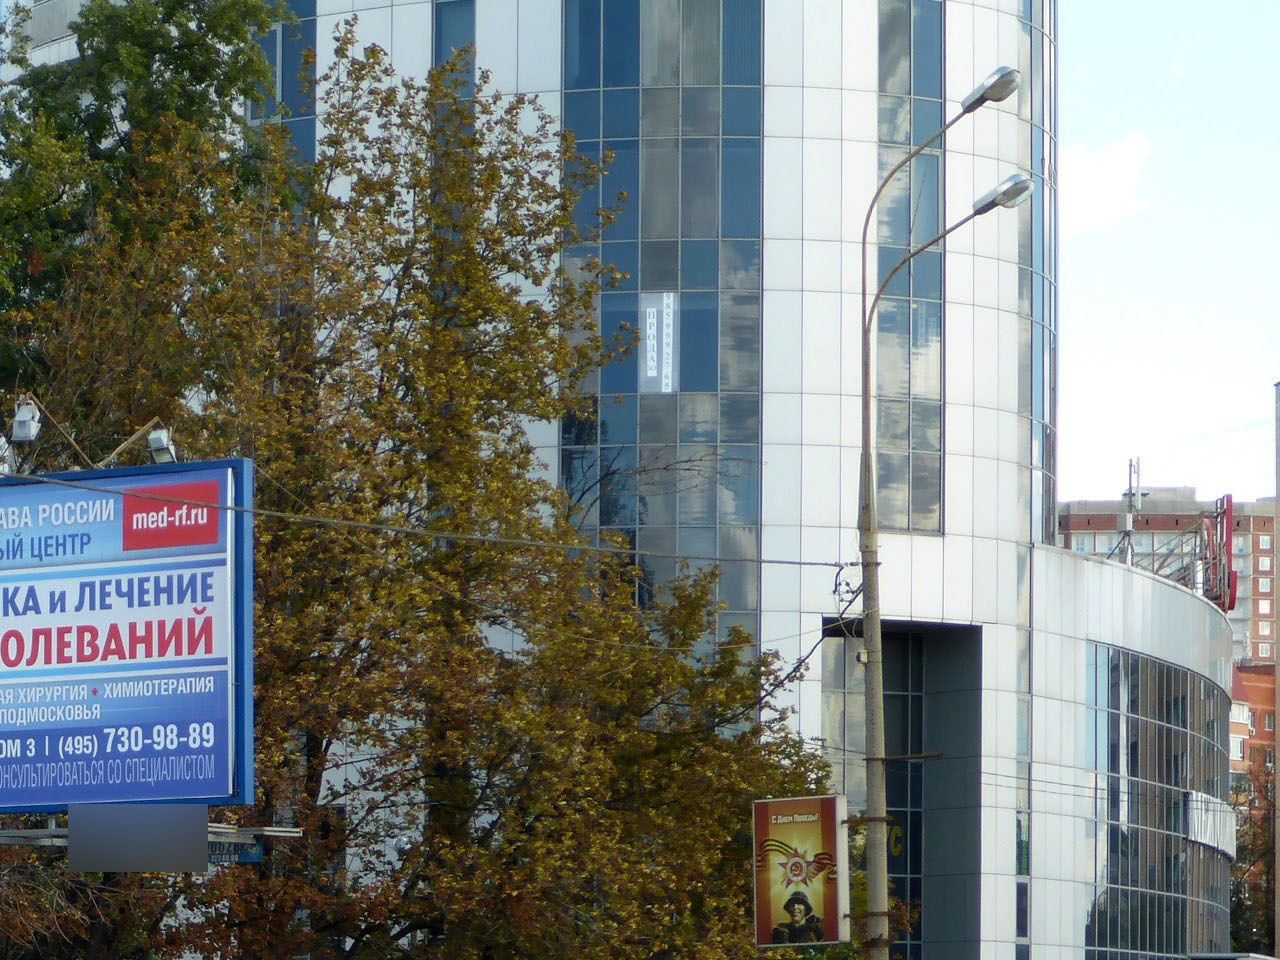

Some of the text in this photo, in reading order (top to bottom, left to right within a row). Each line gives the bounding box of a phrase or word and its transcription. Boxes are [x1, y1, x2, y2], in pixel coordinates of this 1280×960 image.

[38, 498, 116, 528] РОССИИ
[132, 506, 208, 531] med-rf.ru
[30, 532, 92, 563] ЦЕНТР
[74, 571, 215, 613] ЛЕЧЕНИЕ
[18, 684, 88, 704] ХИРУРГИЯ
[103, 676, 215, 699] ХИМИОТЕРАПИЯ
[26, 738, 36, 757] 3
[58, 734, 98, 759] (495)
[103, 721, 215, 753] 730-98-89
[107, 759, 123, 785] СО
[125, 754, 215, 786] СПЕЦИАЛИСТОМ
